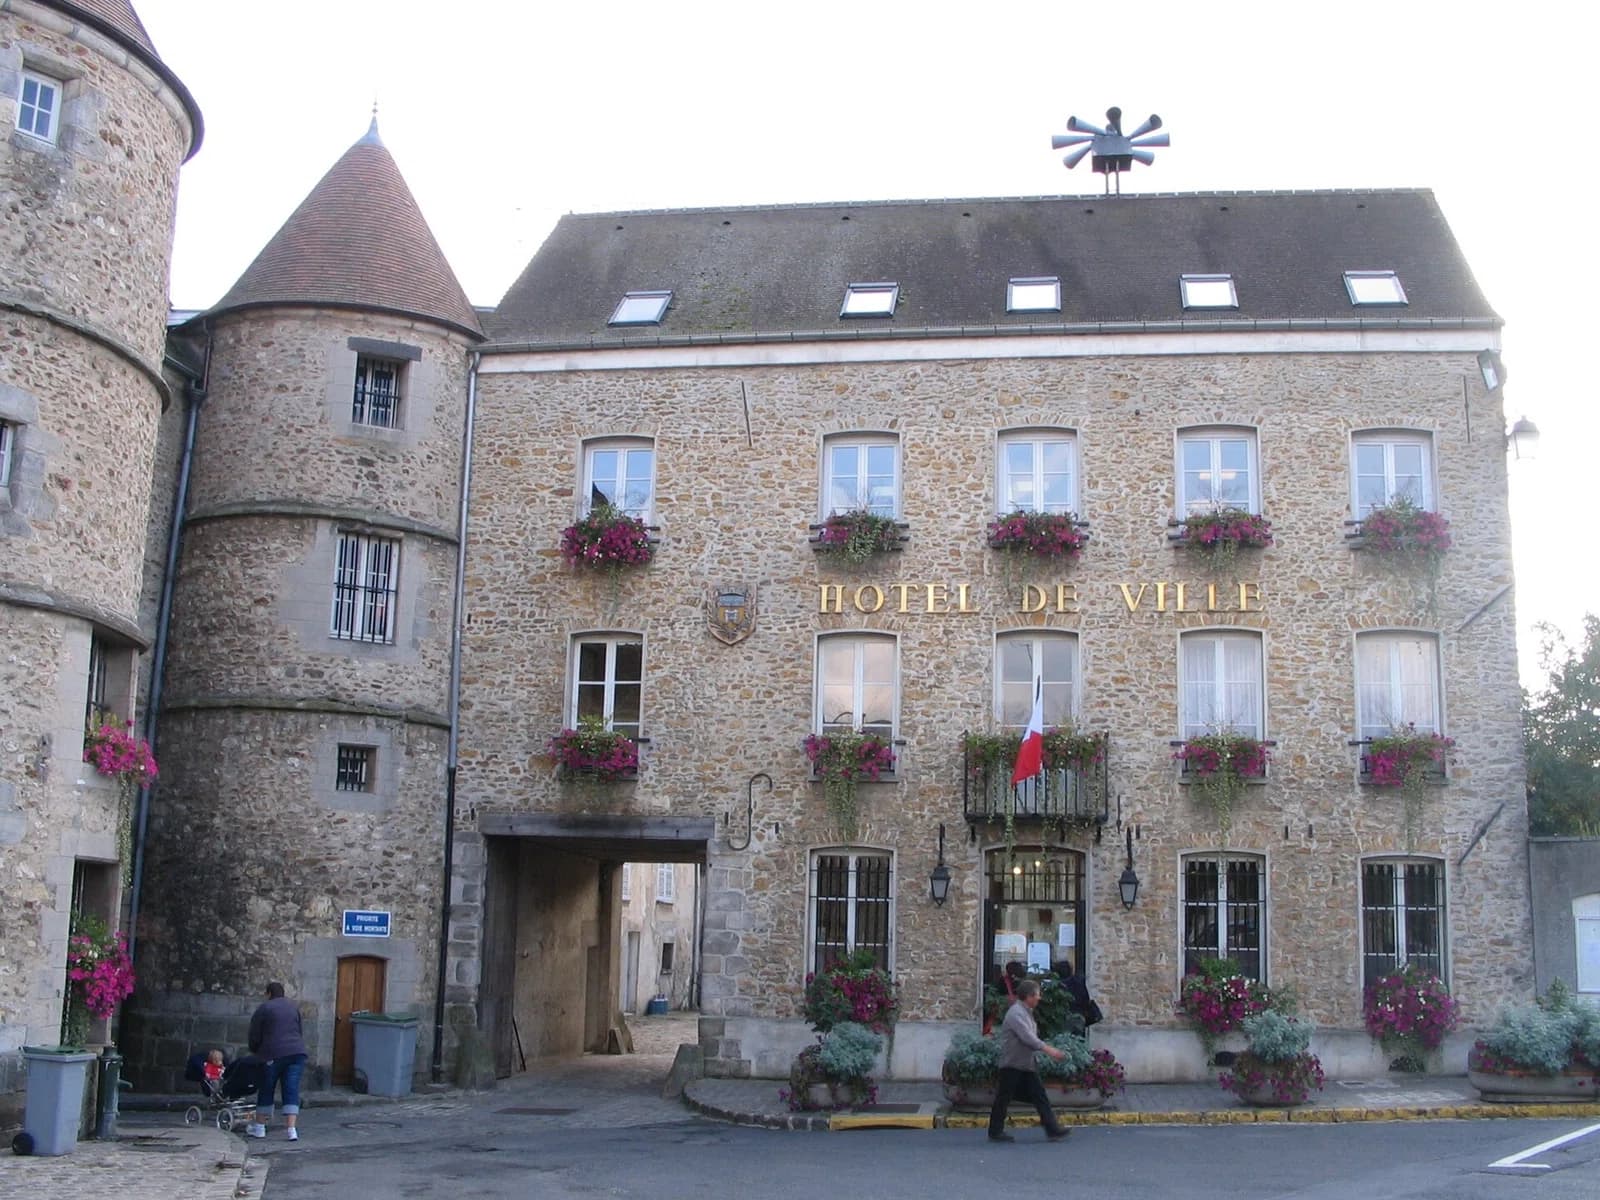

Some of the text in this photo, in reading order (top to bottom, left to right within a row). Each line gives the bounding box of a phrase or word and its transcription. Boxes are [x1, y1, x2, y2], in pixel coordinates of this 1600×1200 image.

[819, 581, 1265, 614] HOTEL DE VILLE
